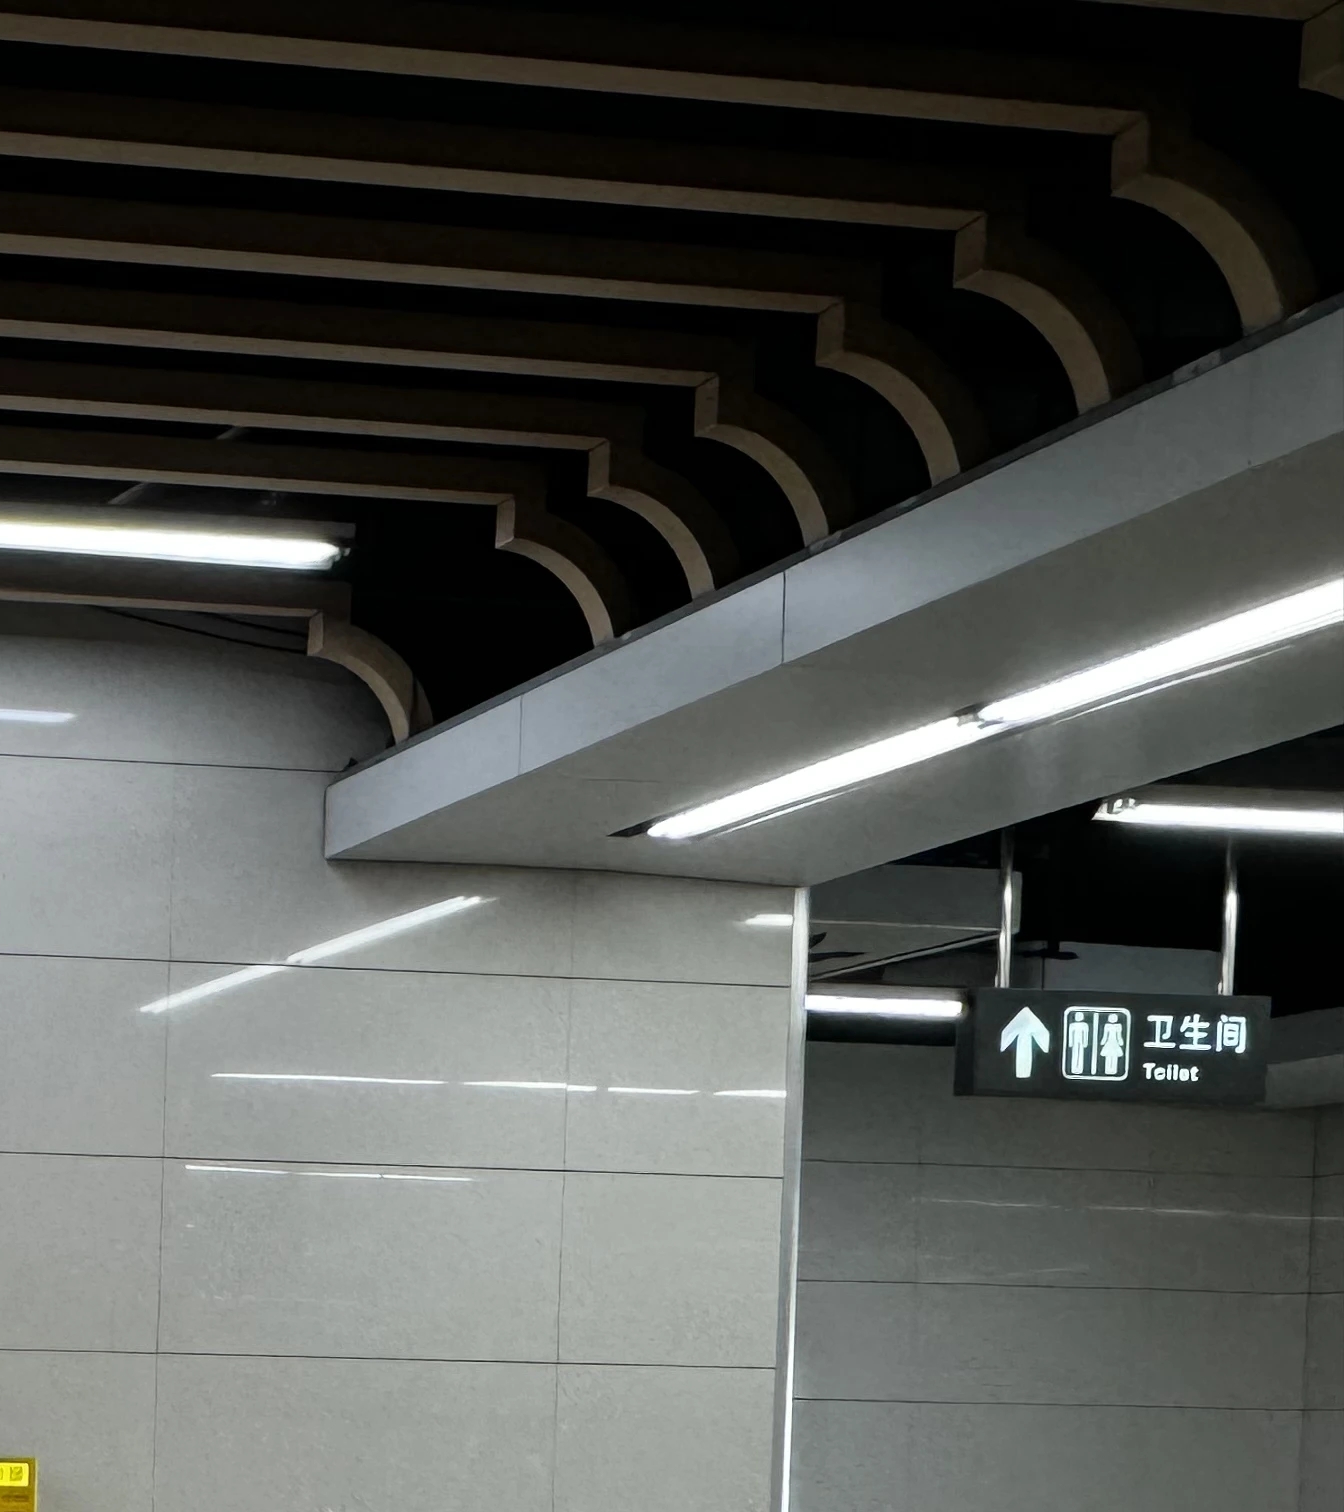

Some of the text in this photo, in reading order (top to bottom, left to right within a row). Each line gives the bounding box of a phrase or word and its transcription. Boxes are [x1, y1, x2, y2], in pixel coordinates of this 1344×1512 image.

[1143, 1013, 1247, 1054] 卫生间
[1142, 1062, 1200, 1082] Toilet
